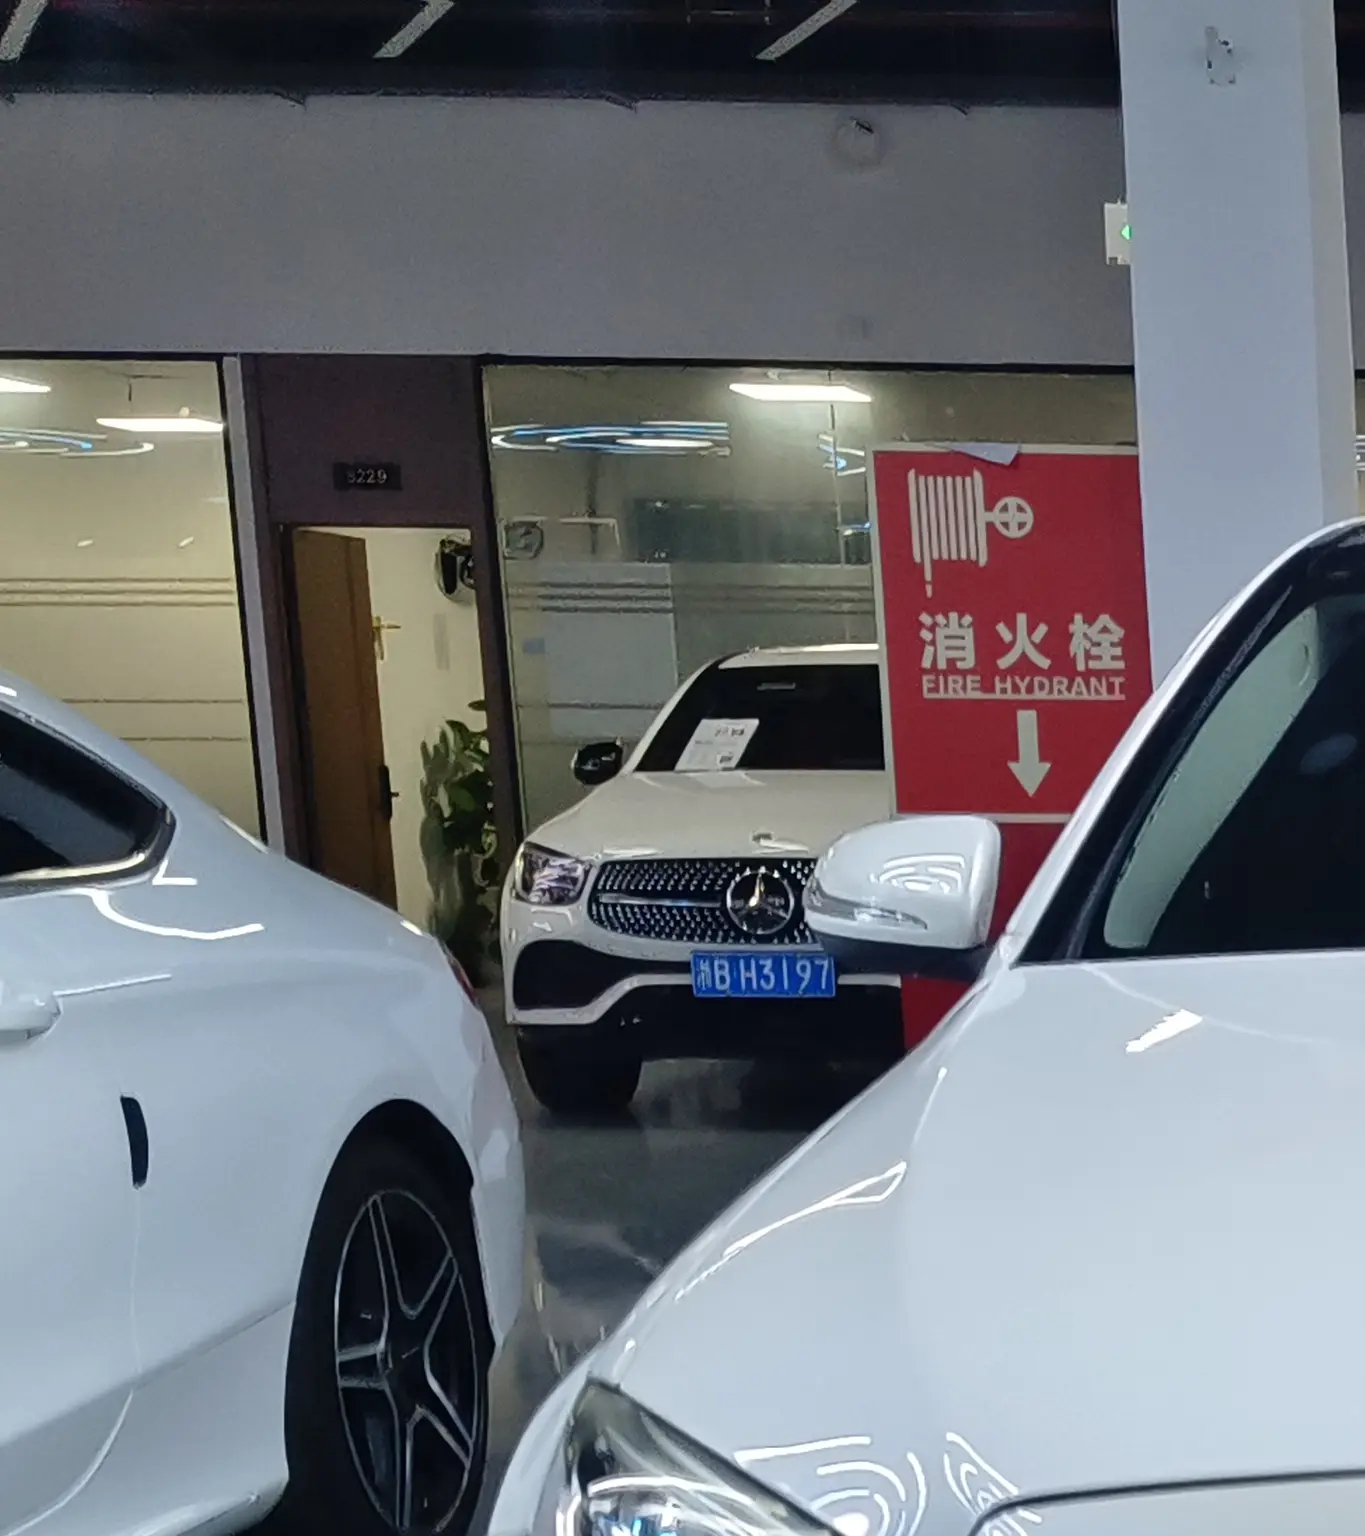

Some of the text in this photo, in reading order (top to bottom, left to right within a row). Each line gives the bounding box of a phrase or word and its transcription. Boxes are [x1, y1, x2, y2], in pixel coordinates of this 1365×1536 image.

[919, 612, 1126, 671] 消火栓
[921, 675, 1125, 697] FIRE HYDRANT
